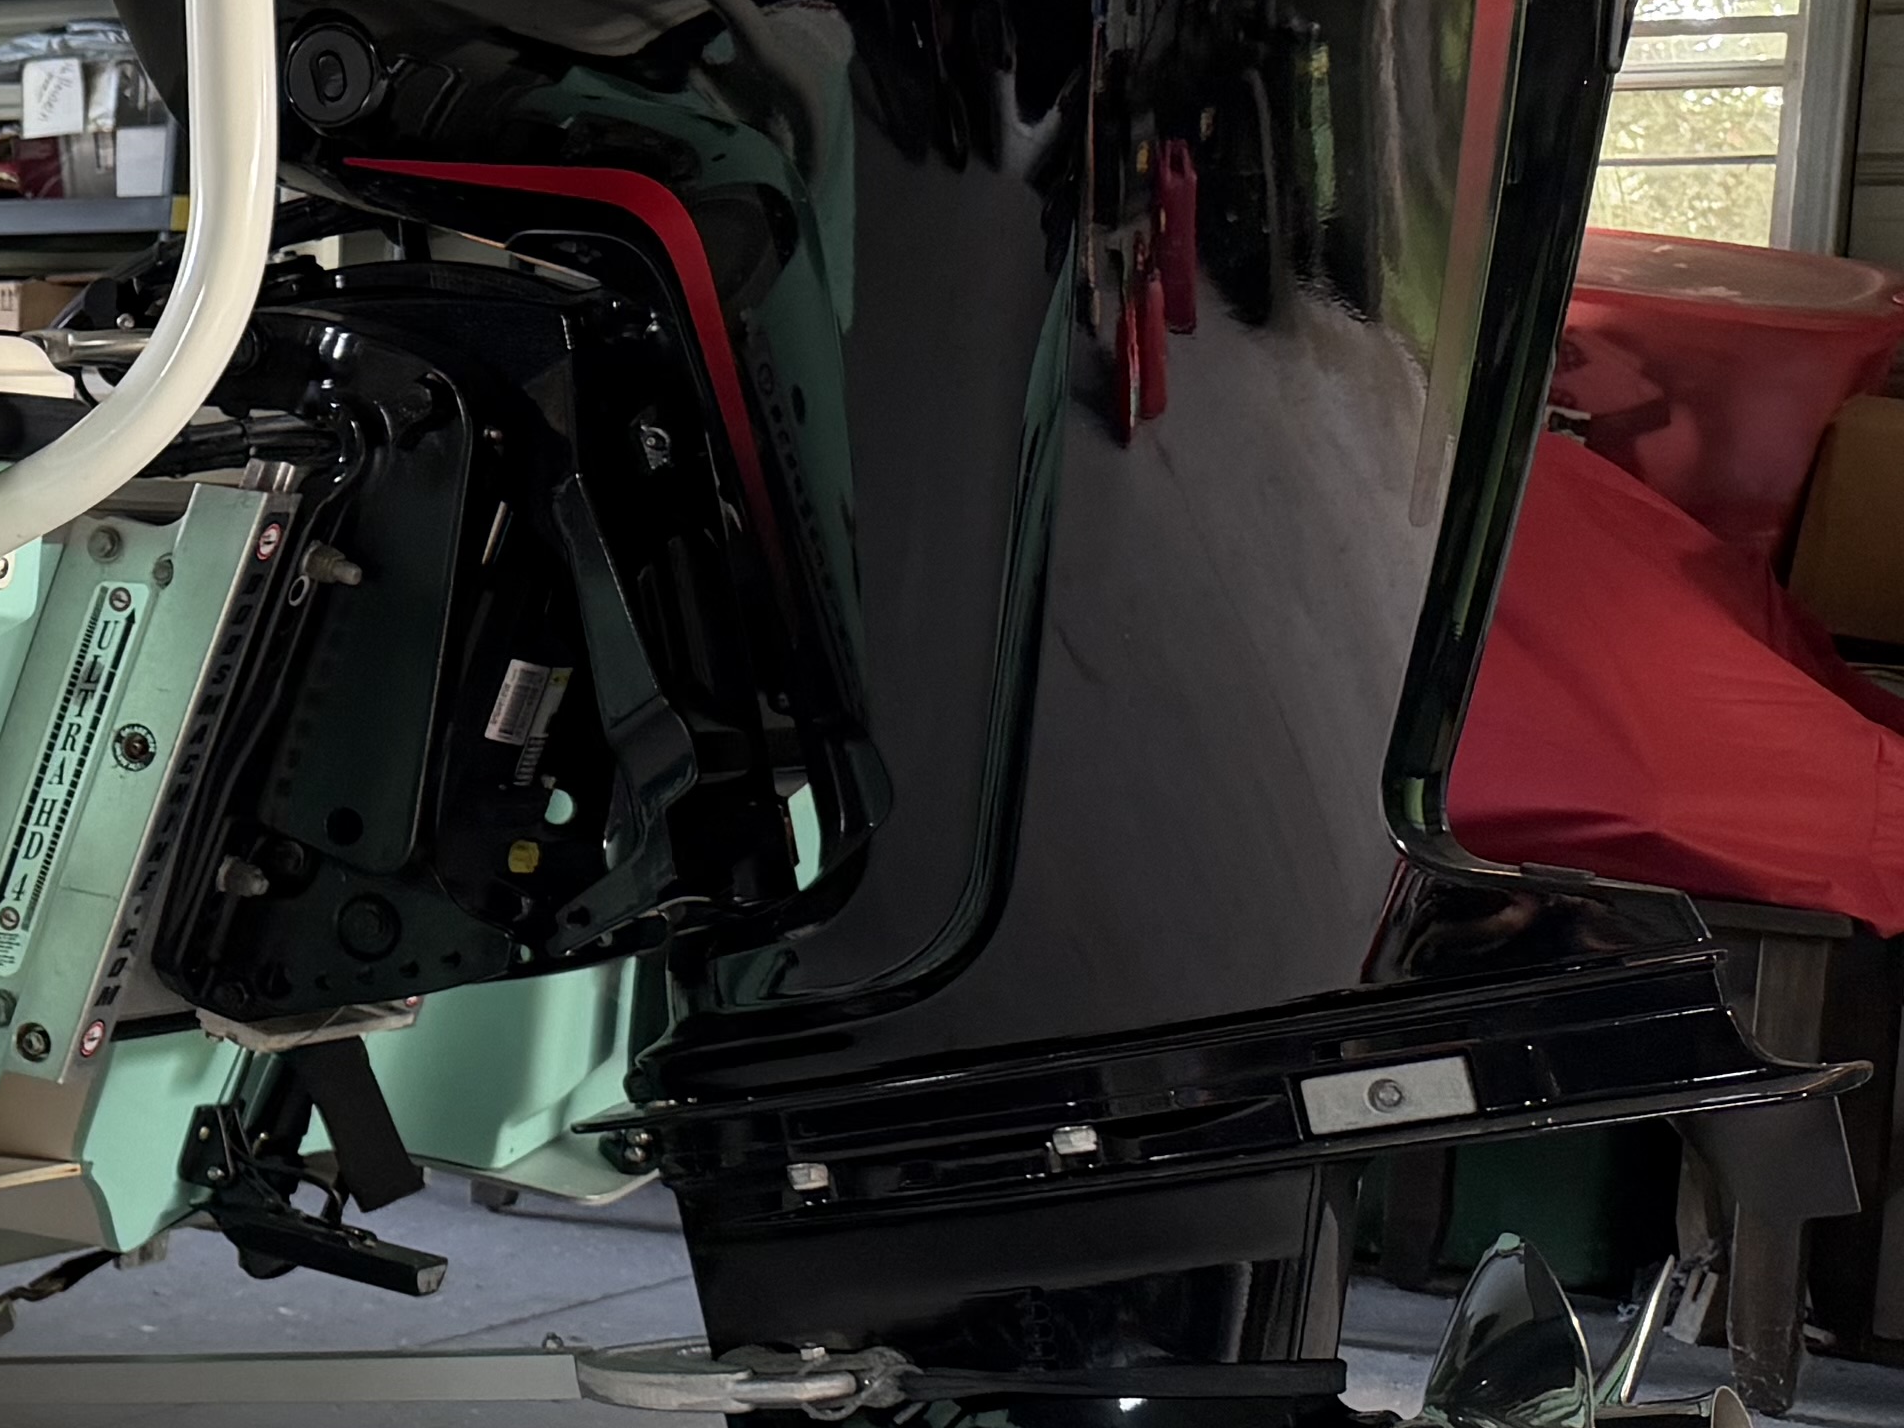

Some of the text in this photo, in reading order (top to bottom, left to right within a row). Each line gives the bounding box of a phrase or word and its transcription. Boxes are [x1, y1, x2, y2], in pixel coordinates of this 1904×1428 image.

[10, 619, 122, 903] ULTRA HD 4
